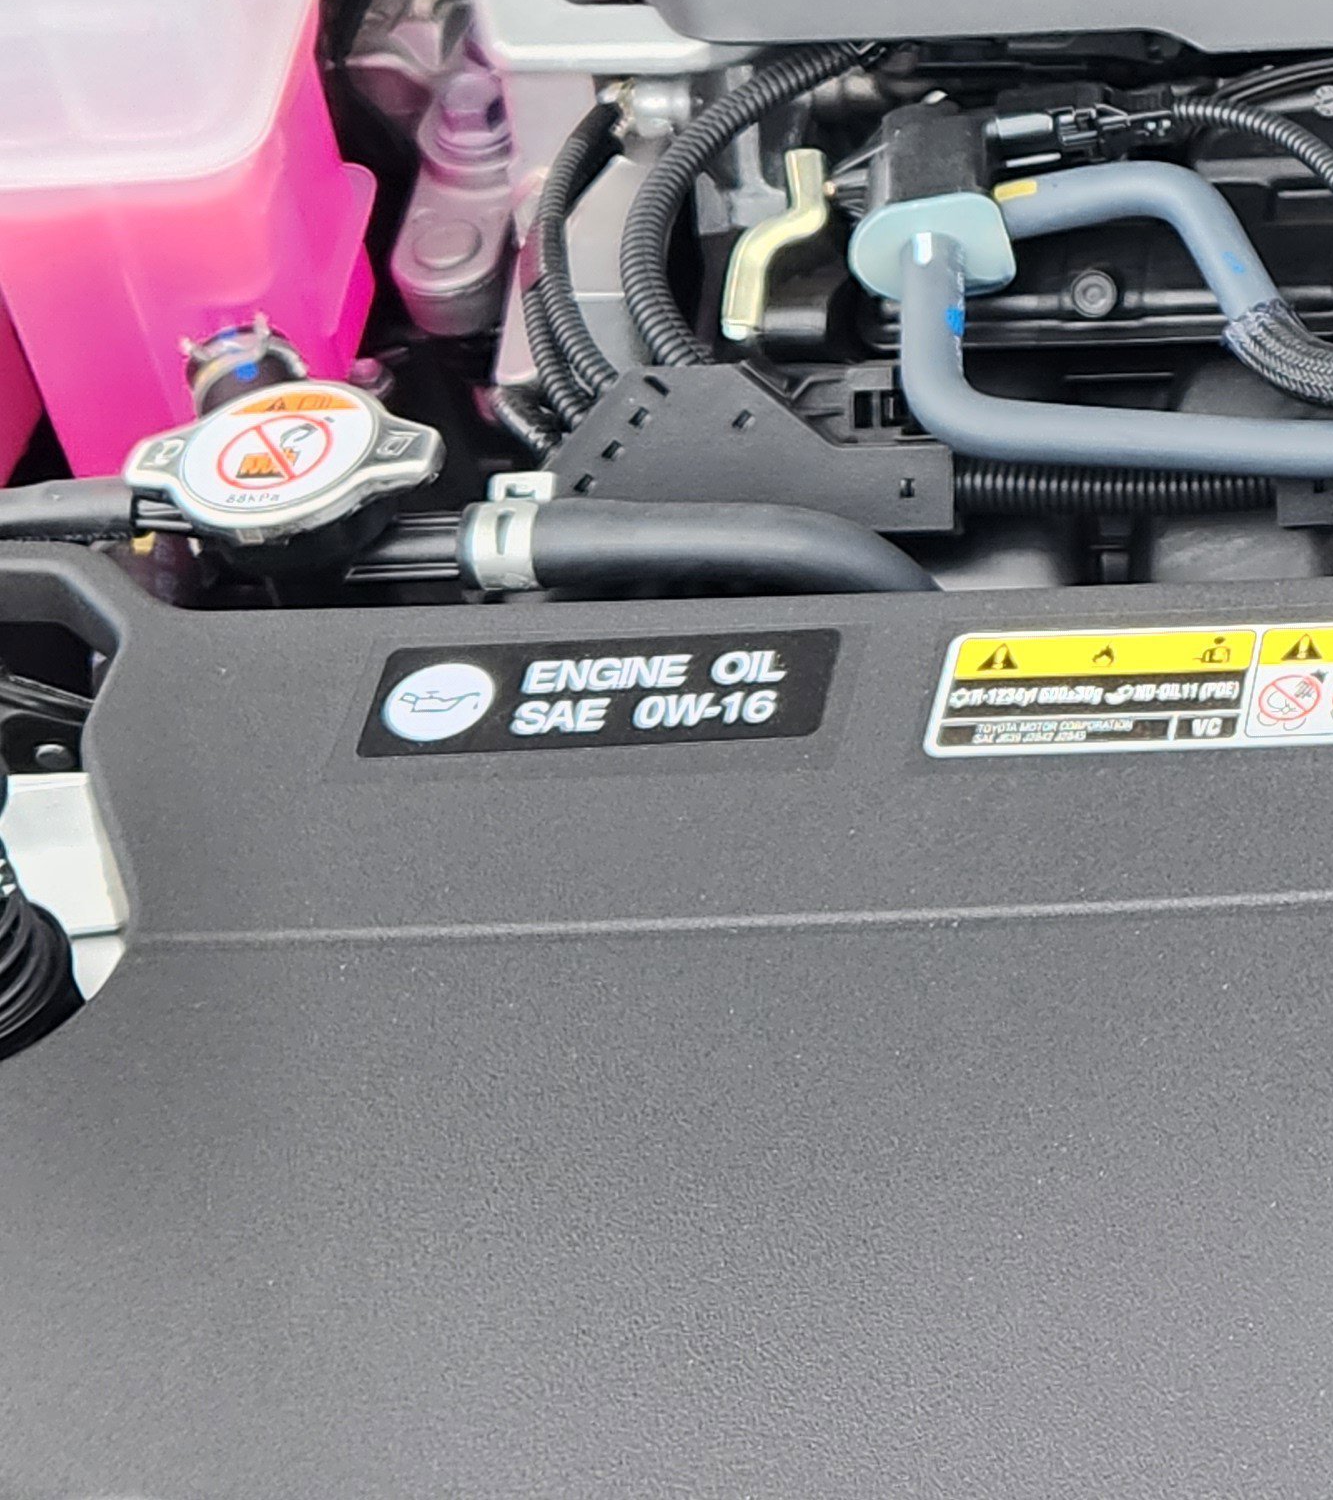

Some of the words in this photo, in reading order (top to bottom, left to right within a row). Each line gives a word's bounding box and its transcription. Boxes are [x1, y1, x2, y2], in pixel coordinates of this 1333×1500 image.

[520, 654, 694, 694] ENGINE
[710, 650, 788, 685] OIL
[509, 697, 612, 736] SAE
[632, 689, 778, 730] 0W-16
[975, 721, 1018, 734] TOYOTA
[1019, 720, 1058, 732] MOTOR
[1059, 718, 1134, 733] CORPORATION
